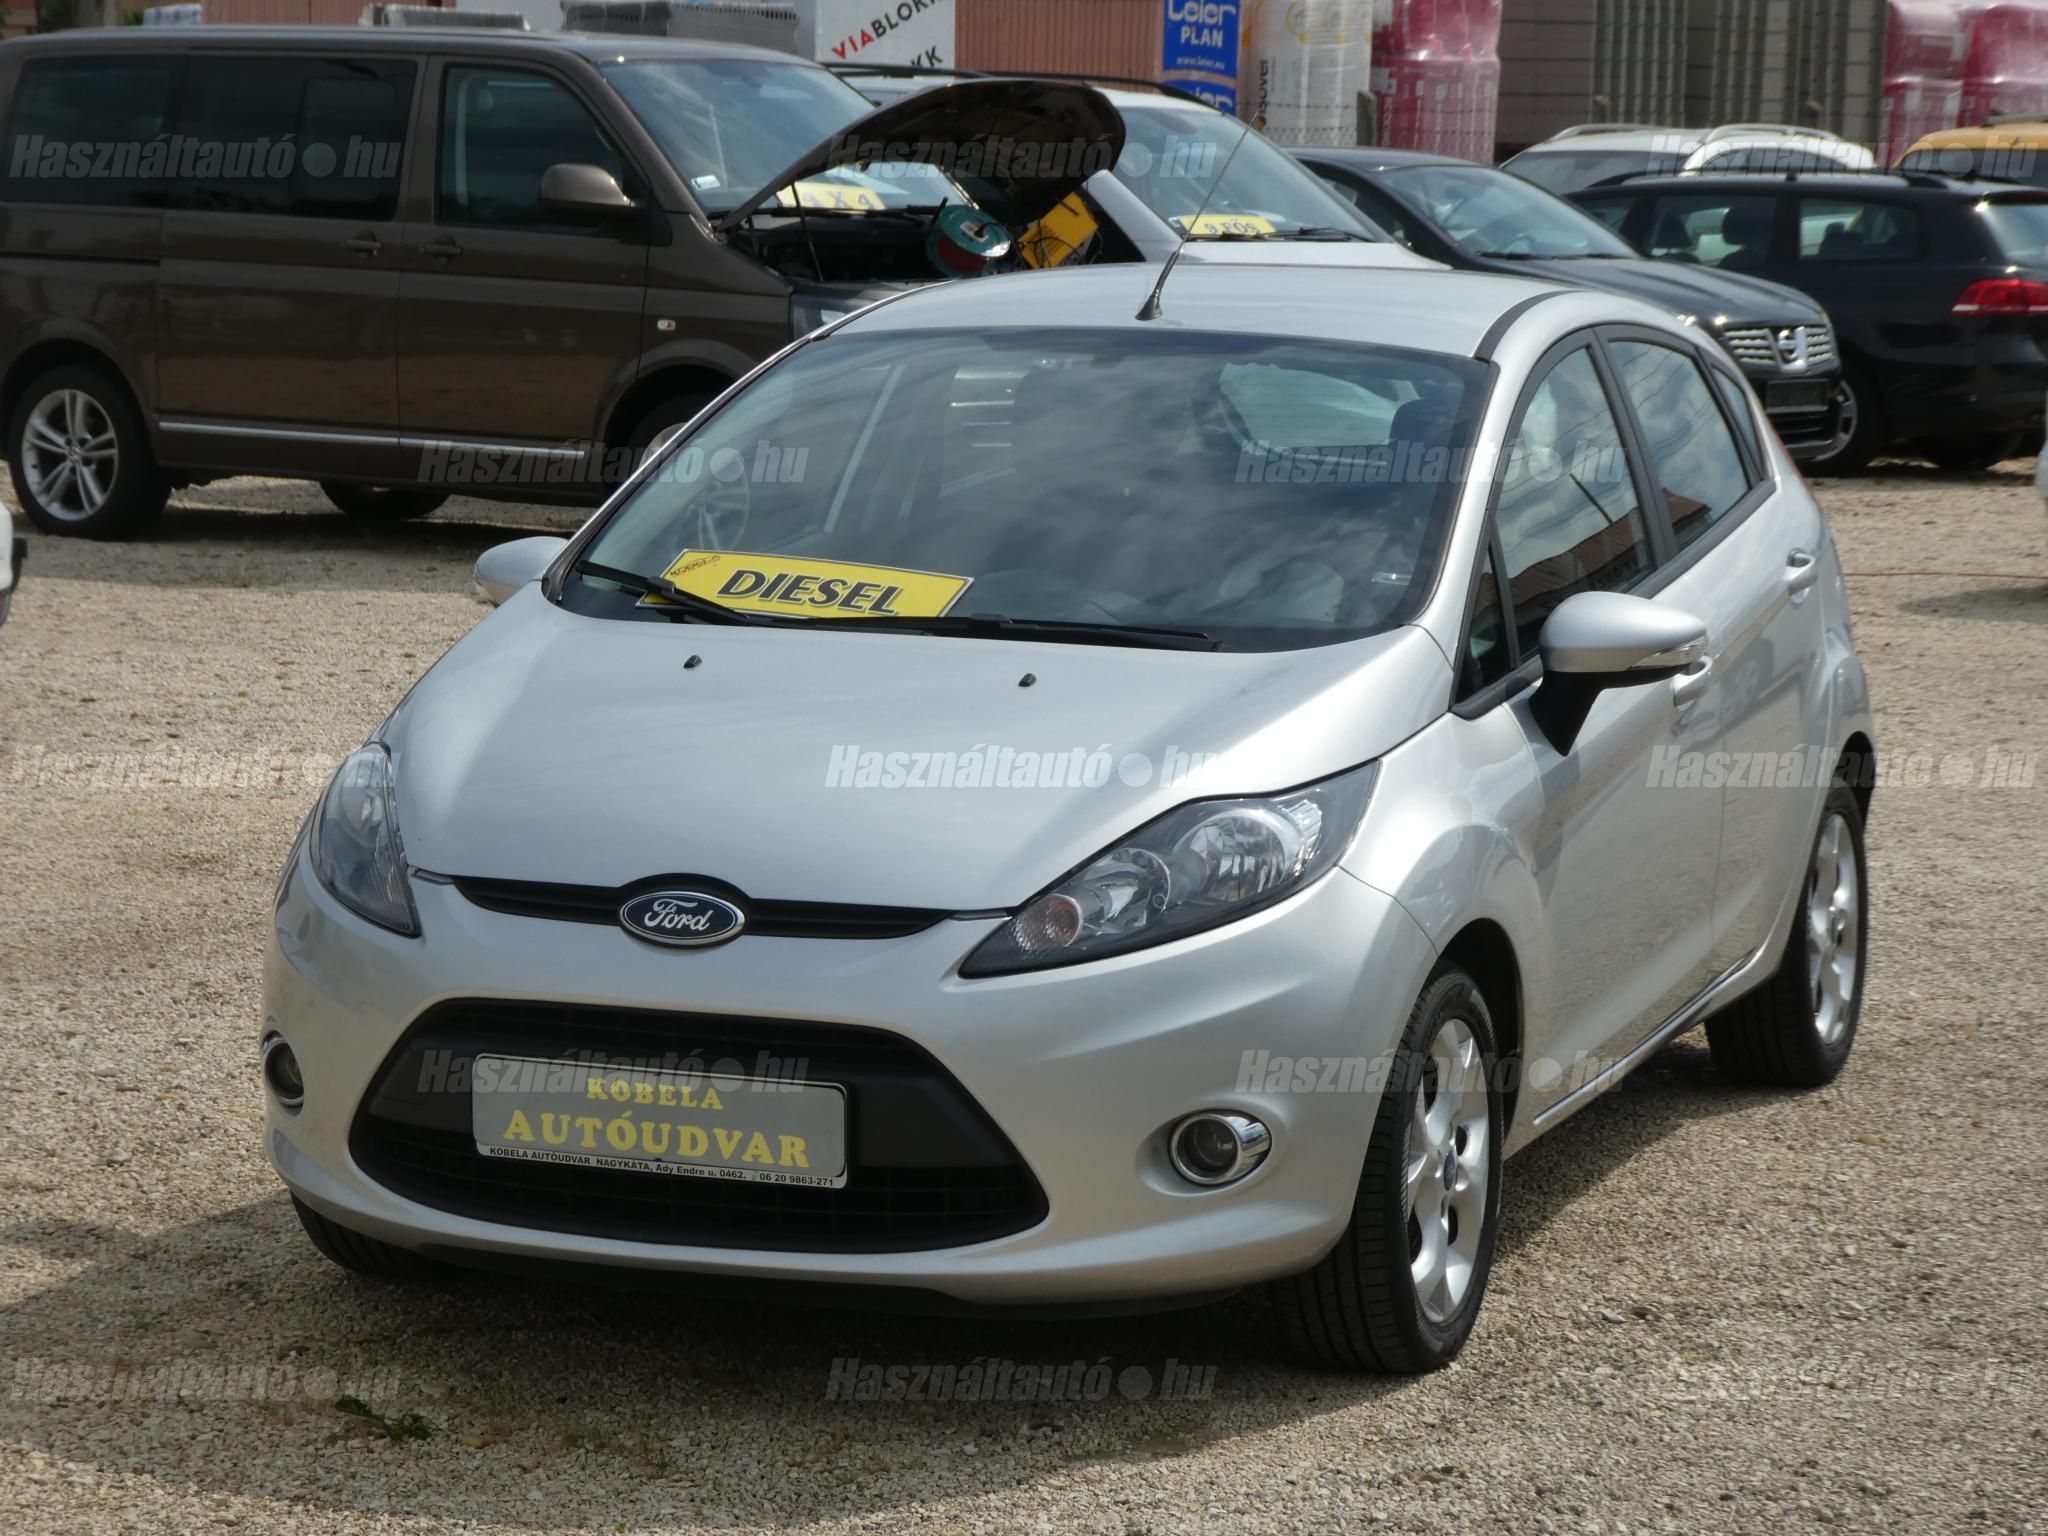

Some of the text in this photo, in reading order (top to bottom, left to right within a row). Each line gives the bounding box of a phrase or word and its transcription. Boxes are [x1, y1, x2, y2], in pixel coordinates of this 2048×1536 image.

[832, 0, 937, 60] VIABLOK
[1180, 25, 1224, 48] PLAN
[716, 569, 904, 616] DIESEL
[643, 898, 714, 931] Ford
[586, 1077, 724, 1110] KOBELA
[503, 1109, 810, 1168] AUTÓUDVAR
[489, 1146, 529, 1159] KOBELA
[531, 1151, 591, 1165] AUTÓUDVAR
[655, 1163, 674, 1175] Ady
[677, 1165, 705, 1176] Endre
[719, 1170, 746, 1180] 0462.
[759, 1172, 772, 1182] 06
[774, 1174, 787, 1183] 20
[789, 1174, 834, 1187] 9863-271
